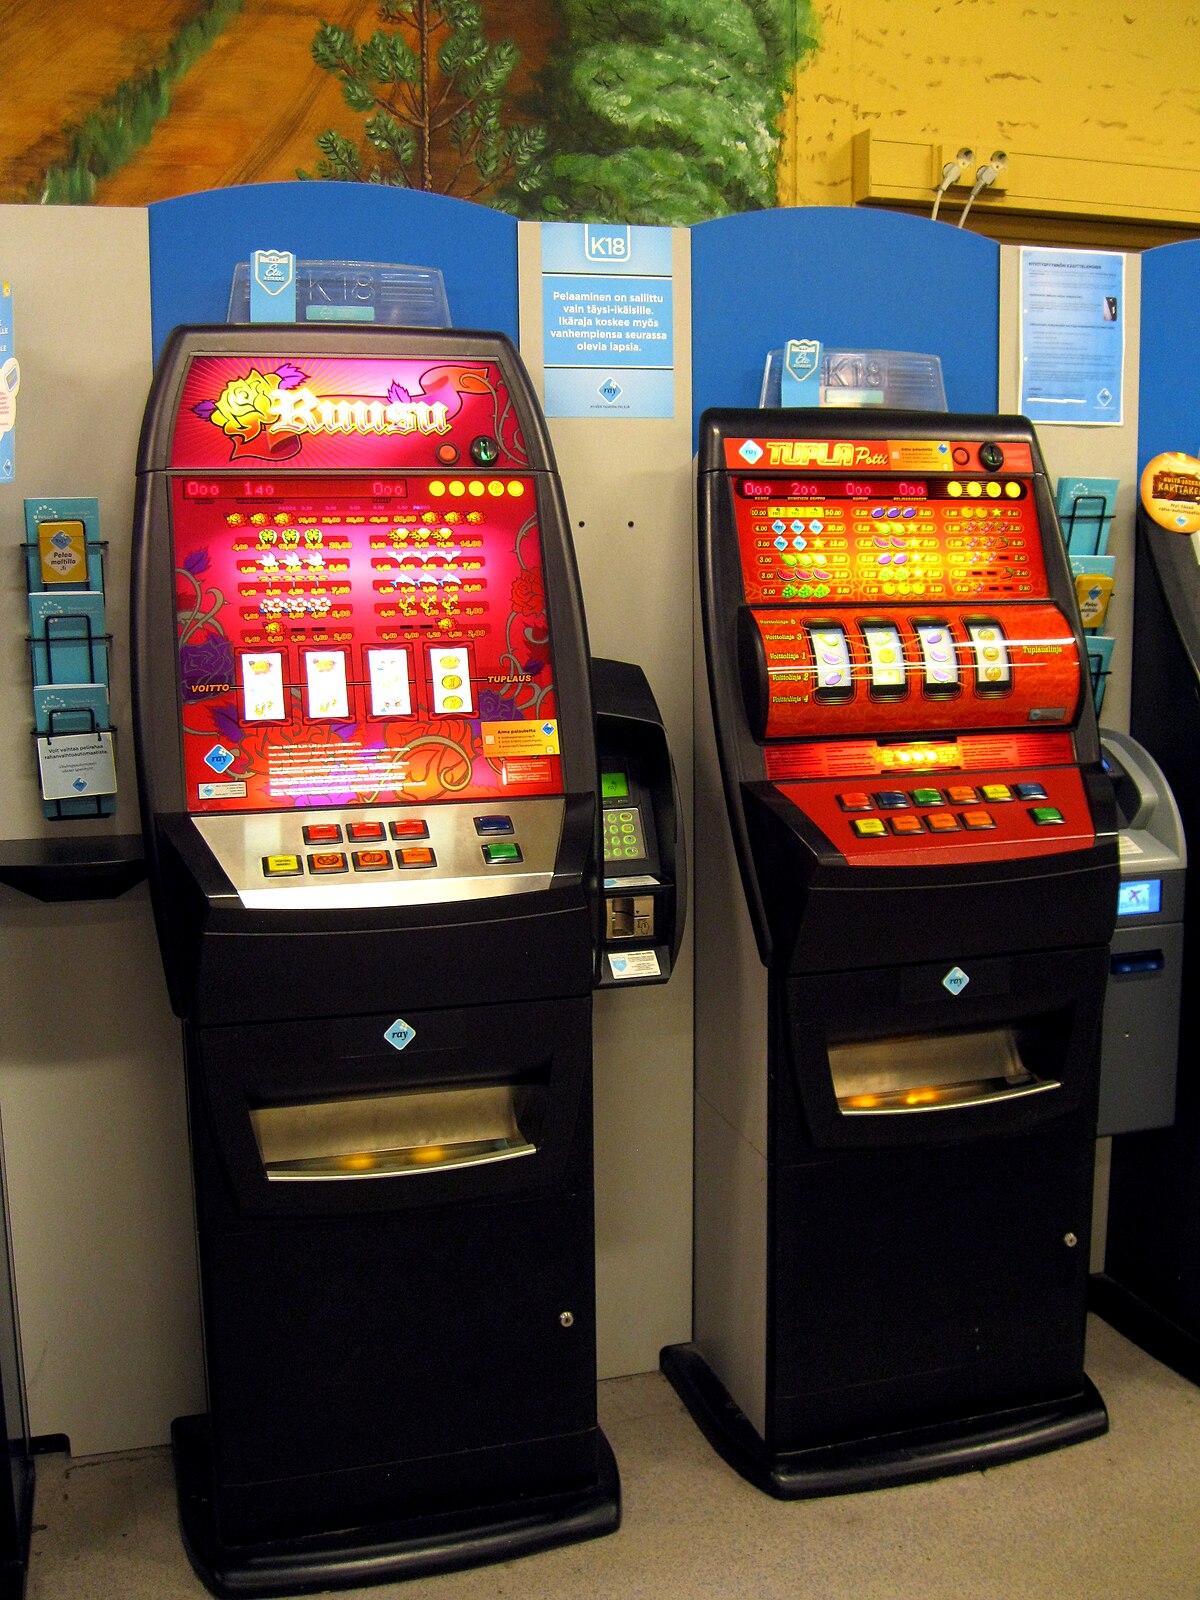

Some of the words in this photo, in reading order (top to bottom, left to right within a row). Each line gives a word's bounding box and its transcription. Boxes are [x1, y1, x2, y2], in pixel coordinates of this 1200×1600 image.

[591, 236, 625, 256] K18
[309, 270, 375, 301] K18
[553, 292, 611, 301] Pelaaminen
[614, 294, 626, 302] on
[630, 293, 663, 303] sallittu
[563, 304, 584, 314] vain
[587, 305, 654, 315] täysi-ikäisille.
[559, 317, 592, 327] Ikäraja
[595, 317, 630, 327] koskee
[632, 318, 659, 328] myös
[551, 330, 623, 340] vanhempiensa
[625, 331, 667, 340] seurassa
[577, 342, 607, 351] olevia
[610, 342, 641, 353] lapsia.
[825, 356, 883, 387] K18
[603, 387, 617, 396] ray
[269, 388, 452, 435] Ruusu
[766, 442, 855, 466] TUPLA
[855, 446, 889, 465] Potti
[1022, 645, 1063, 655] Tuplauslinja
[487, 675, 532, 683] TUPLAUS
[803, 672, 809, 681] 2
[191, 684, 230, 693] VOITTO
[803, 695, 809, 703] 4
[211, 755, 227, 765] ray
[950, 978, 963, 987] ray
[392, 1031, 408, 1041] ray
